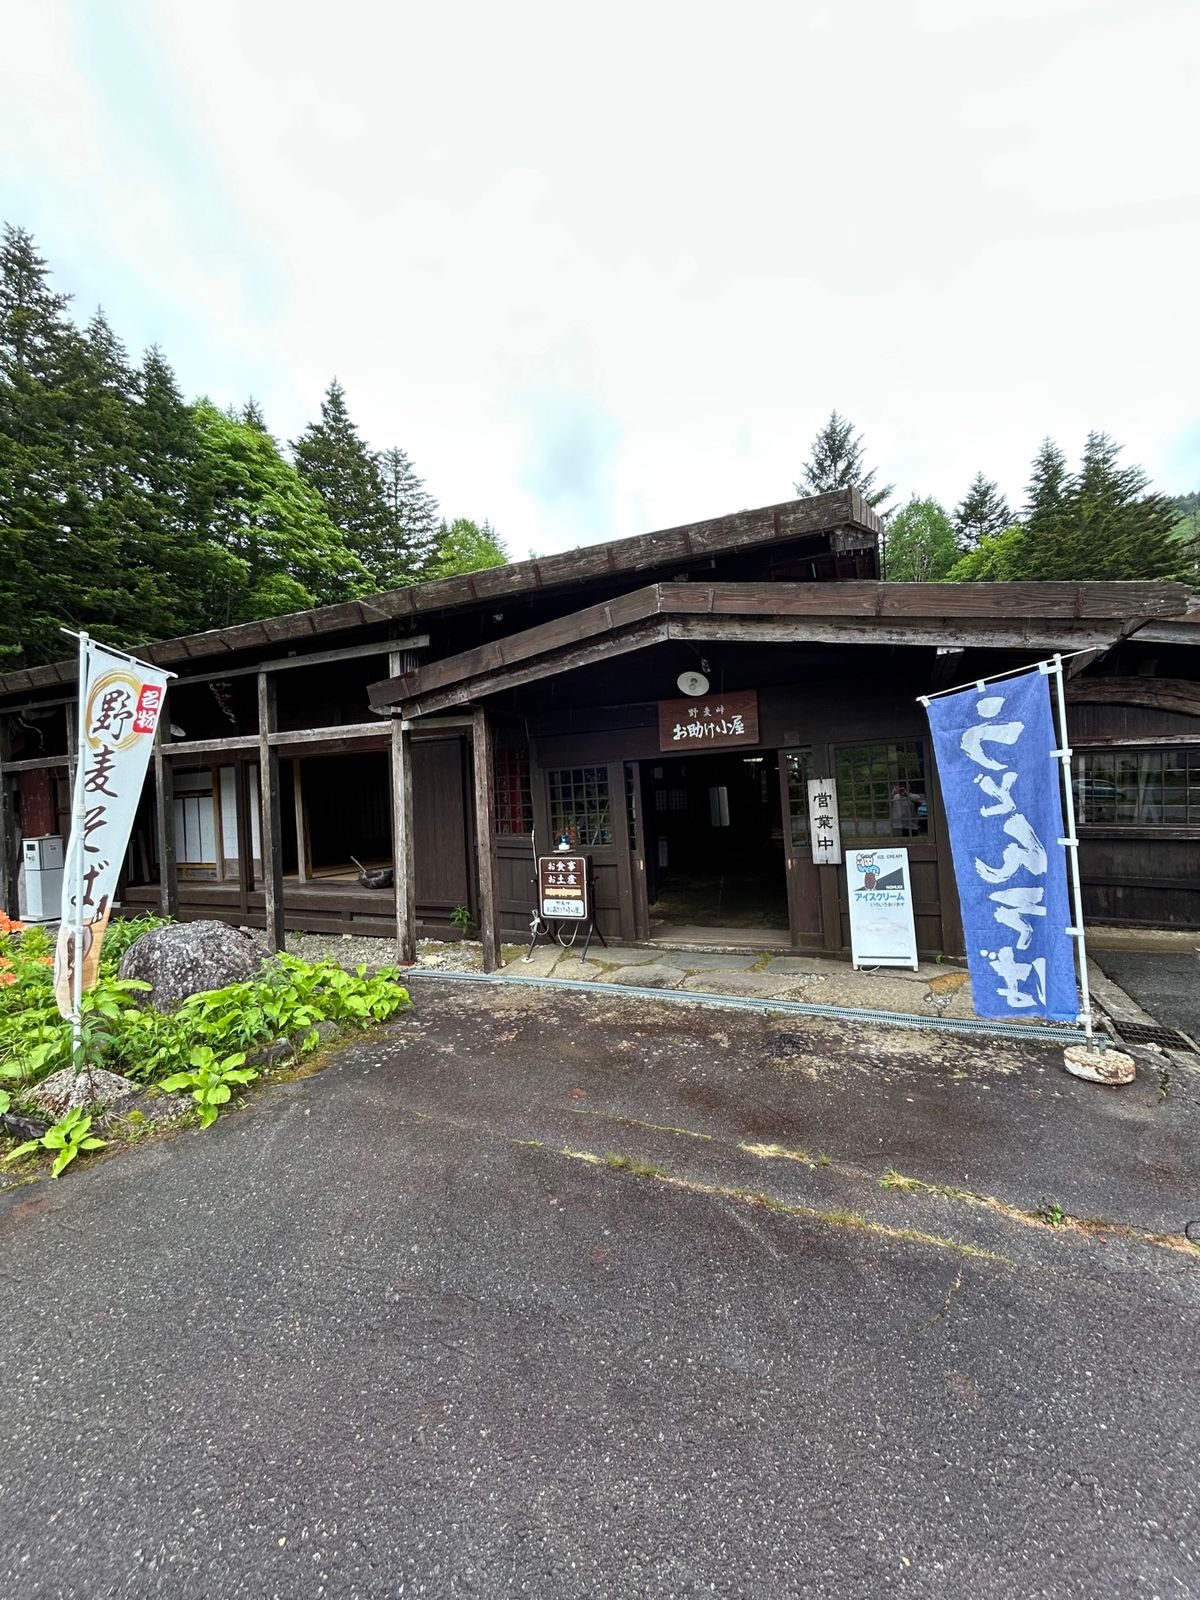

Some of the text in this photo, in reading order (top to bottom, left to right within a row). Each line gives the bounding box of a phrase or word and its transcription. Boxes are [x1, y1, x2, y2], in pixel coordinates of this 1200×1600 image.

[136, 690, 160, 730] 名物
[687, 704, 725, 718] 野麦峠
[673, 715, 745, 740] お助け小屋
[813, 792, 834, 851] 営業中
[547, 861, 576, 871] お食事
[548, 874, 577, 885] お土産
[854, 892, 905, 902] アイスクリーム
